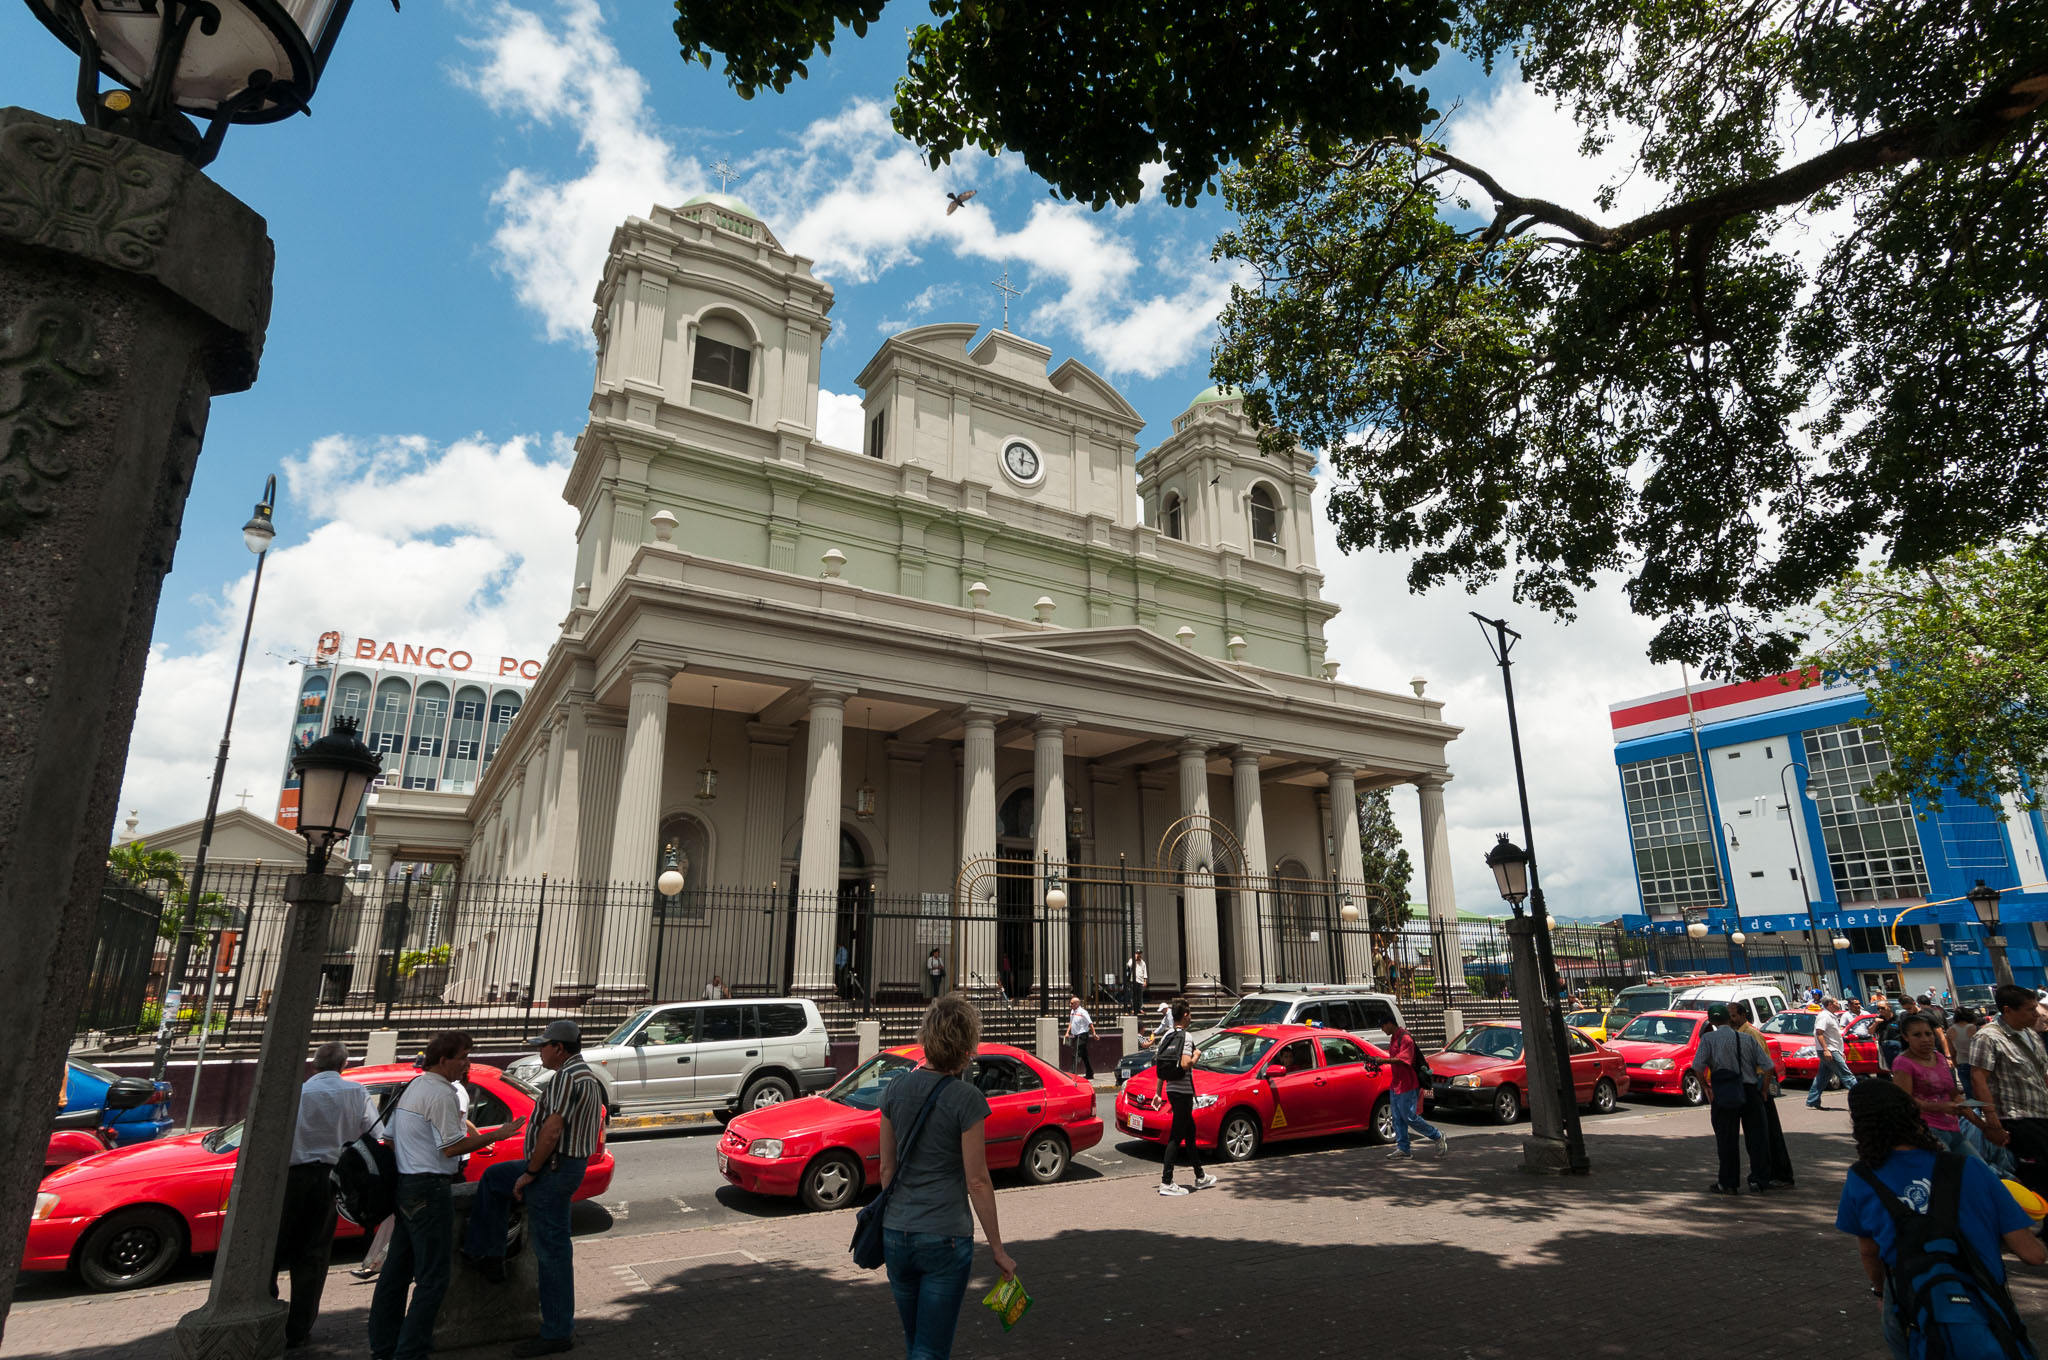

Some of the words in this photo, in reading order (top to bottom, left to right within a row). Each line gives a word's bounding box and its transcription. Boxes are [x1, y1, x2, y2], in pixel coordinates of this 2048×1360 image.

[355, 637, 473, 671] BANCO
[1751, 918, 1773, 930] de
[1788, 913, 1904, 929] Tarjetas
